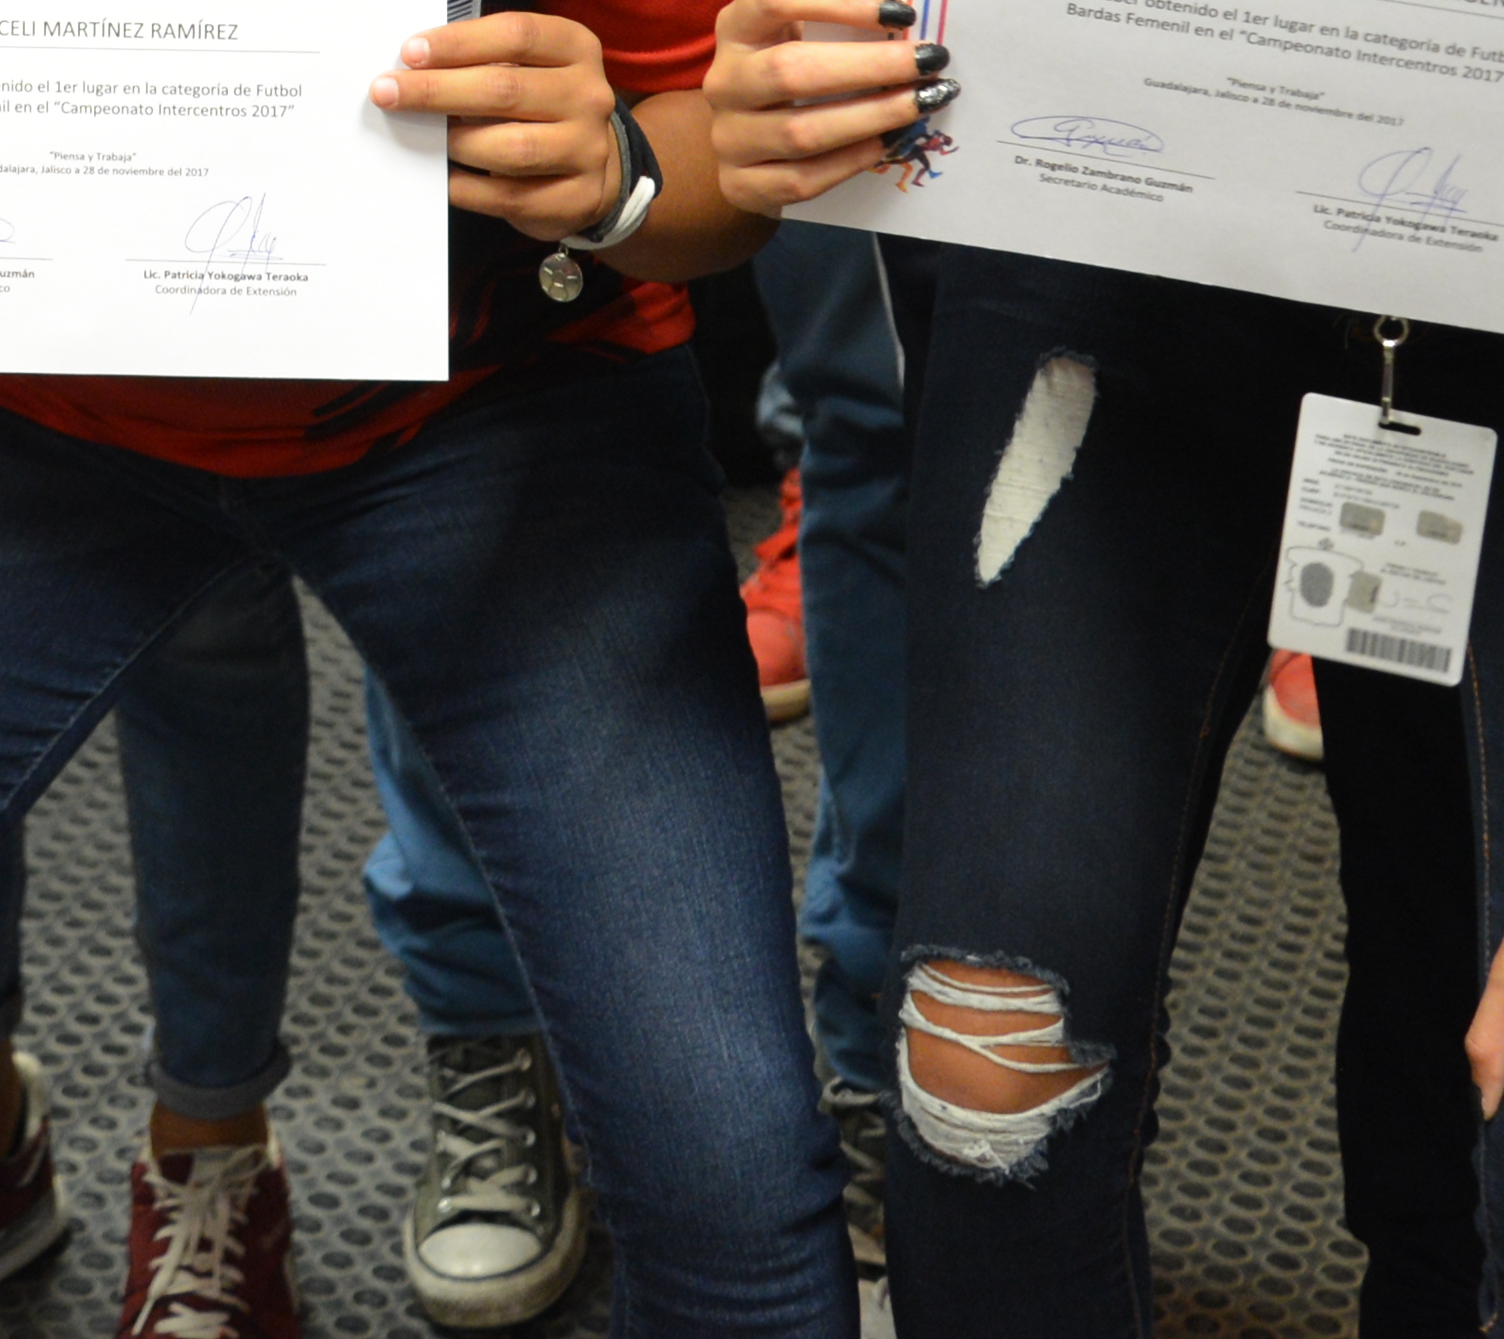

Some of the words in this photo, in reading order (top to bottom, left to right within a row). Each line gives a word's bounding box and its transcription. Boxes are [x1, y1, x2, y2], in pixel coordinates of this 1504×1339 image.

[43, 17, 144, 39] MARTÍNEZ
[150, 19, 238, 40] RAMÍREZ
[1221, 8, 1238, 21] el
[1242, 10, 1270, 26] 1er
[1272, 14, 1316, 34] lugar
[1318, 25, 1340, 37] en
[1343, 25, 1359, 41] la
[1362, 32, 1441, 53] categoría
[1443, 42, 1467, 58] de
[1066, 2, 1121, 23] Bardas
[1124, 11, 1190, 33] Femenil
[1193, 25, 1215, 38] en
[1217, 27, 1235, 41] el
[1355, 49, 1457, 76] Intercentros
[36, 79, 50, 93] el
[55, 80, 78, 93] 1er
[82, 80, 118, 97] lugar
[122, 84, 141, 95] en
[144, 81, 157, 95] la
[161, 82, 229, 99] categoría
[233, 82, 251, 97] de
[255, 83, 302, 97] Futbol
[14, 103, 32, 113] en
[36, 100, 49, 114] el
[158, 103, 247, 117] Intercentros
[87, 153, 94, 163] y
[40, 164, 72, 175] Jalisco
[73, 167, 80, 175] a
[82, 165, 95, 175] 28
[96, 165, 110, 175] de
[111, 166, 165, 176] noviembre
[166, 167, 183, 177] del
[184, 167, 209, 177] 2017
[143, 269, 161, 279] Lic.
[163, 269, 205, 280] Patricia
[207, 270, 263, 283] Yokogawa
[264, 271, 309, 282] Teraoka
[154, 283, 227, 296] Coordinadora
[229, 285, 243, 296] de
[245, 285, 297, 297] Extensión
